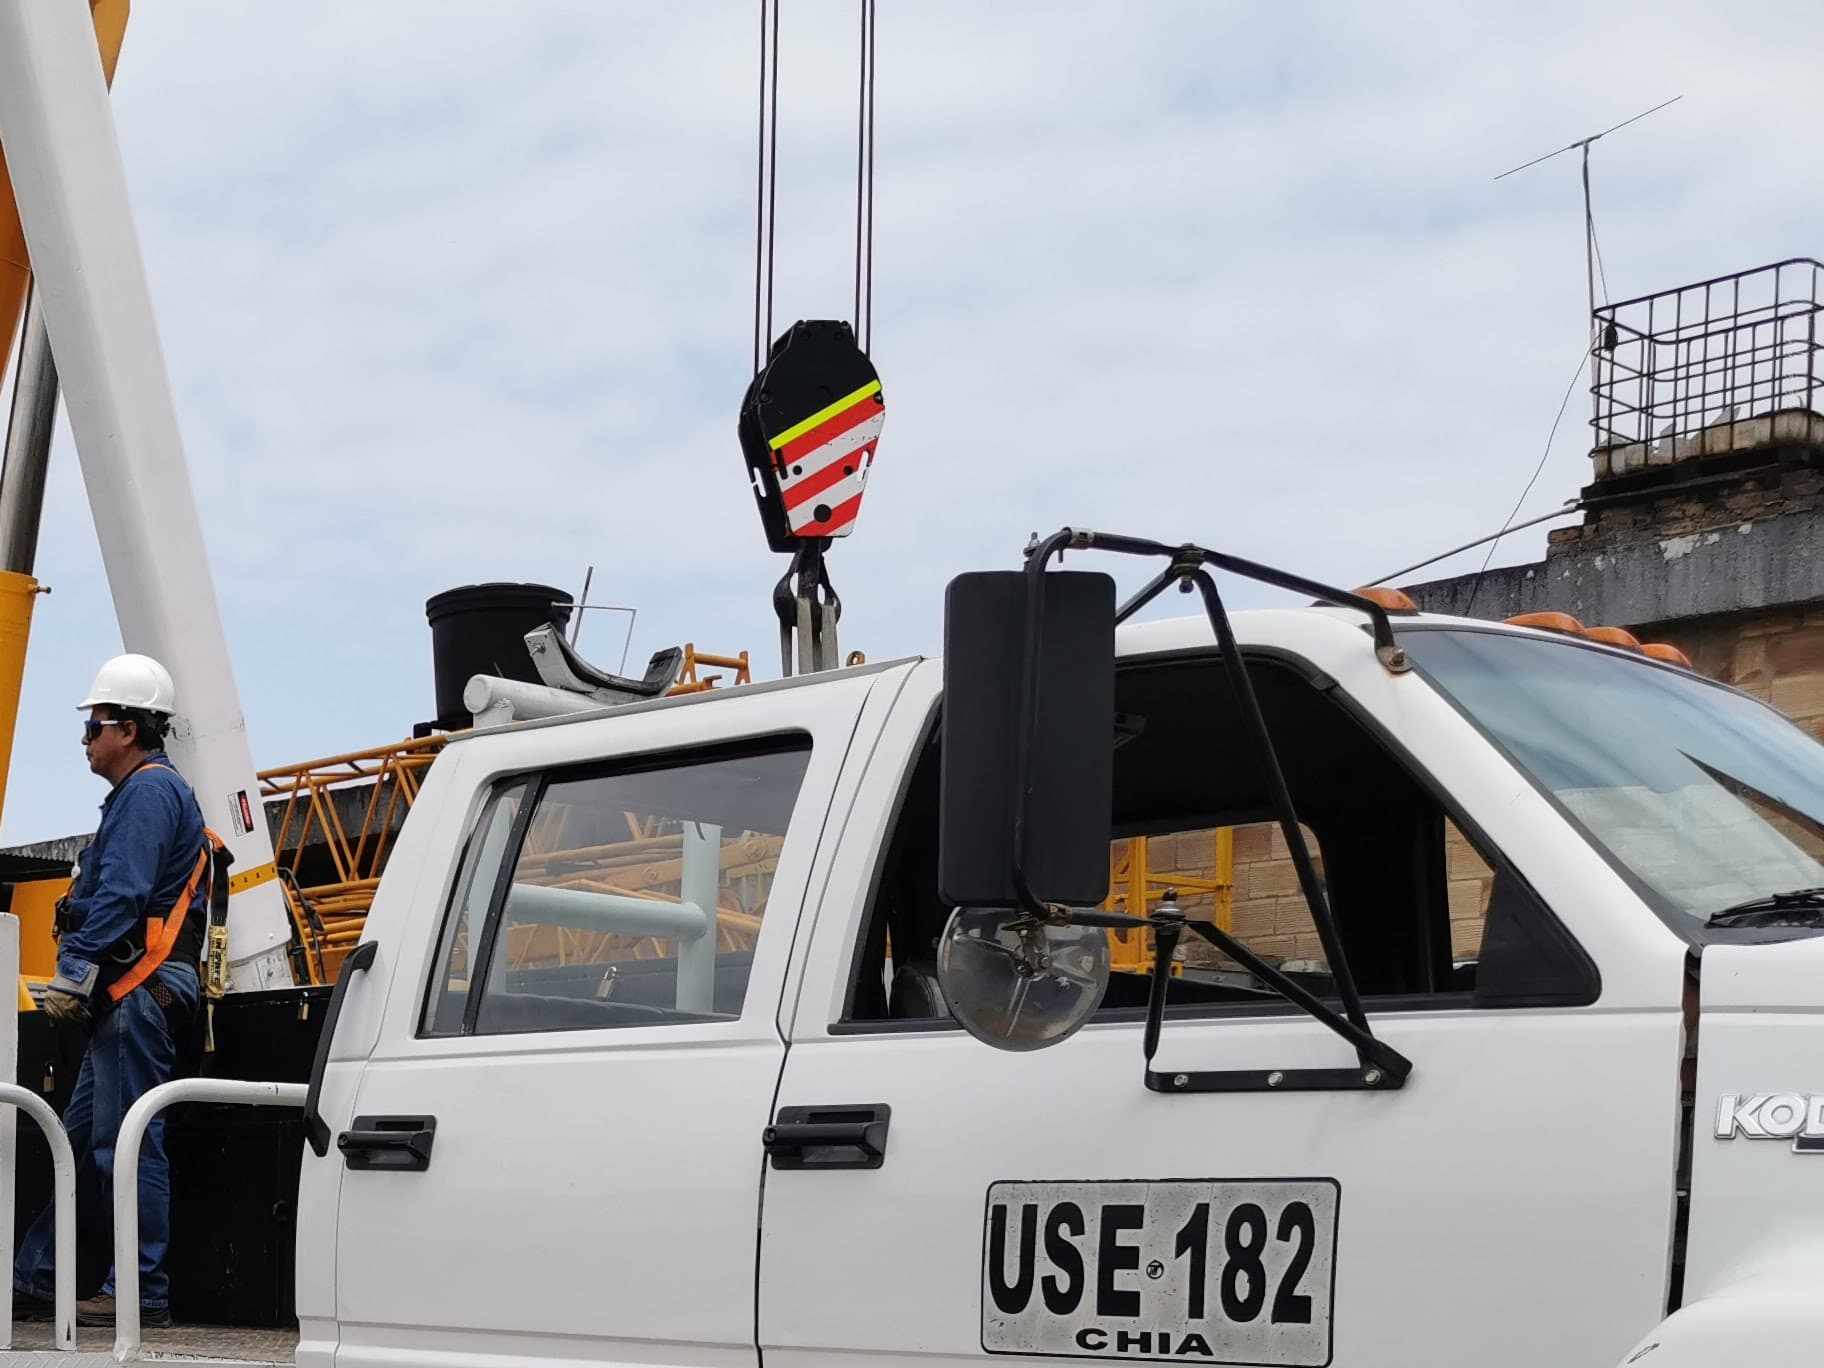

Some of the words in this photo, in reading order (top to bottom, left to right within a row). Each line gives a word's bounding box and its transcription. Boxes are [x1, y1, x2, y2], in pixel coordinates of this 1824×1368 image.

[989, 1200, 1145, 1318] USE
[1174, 1200, 1315, 1325] 182
[1075, 1327, 1214, 1356] CHIA
